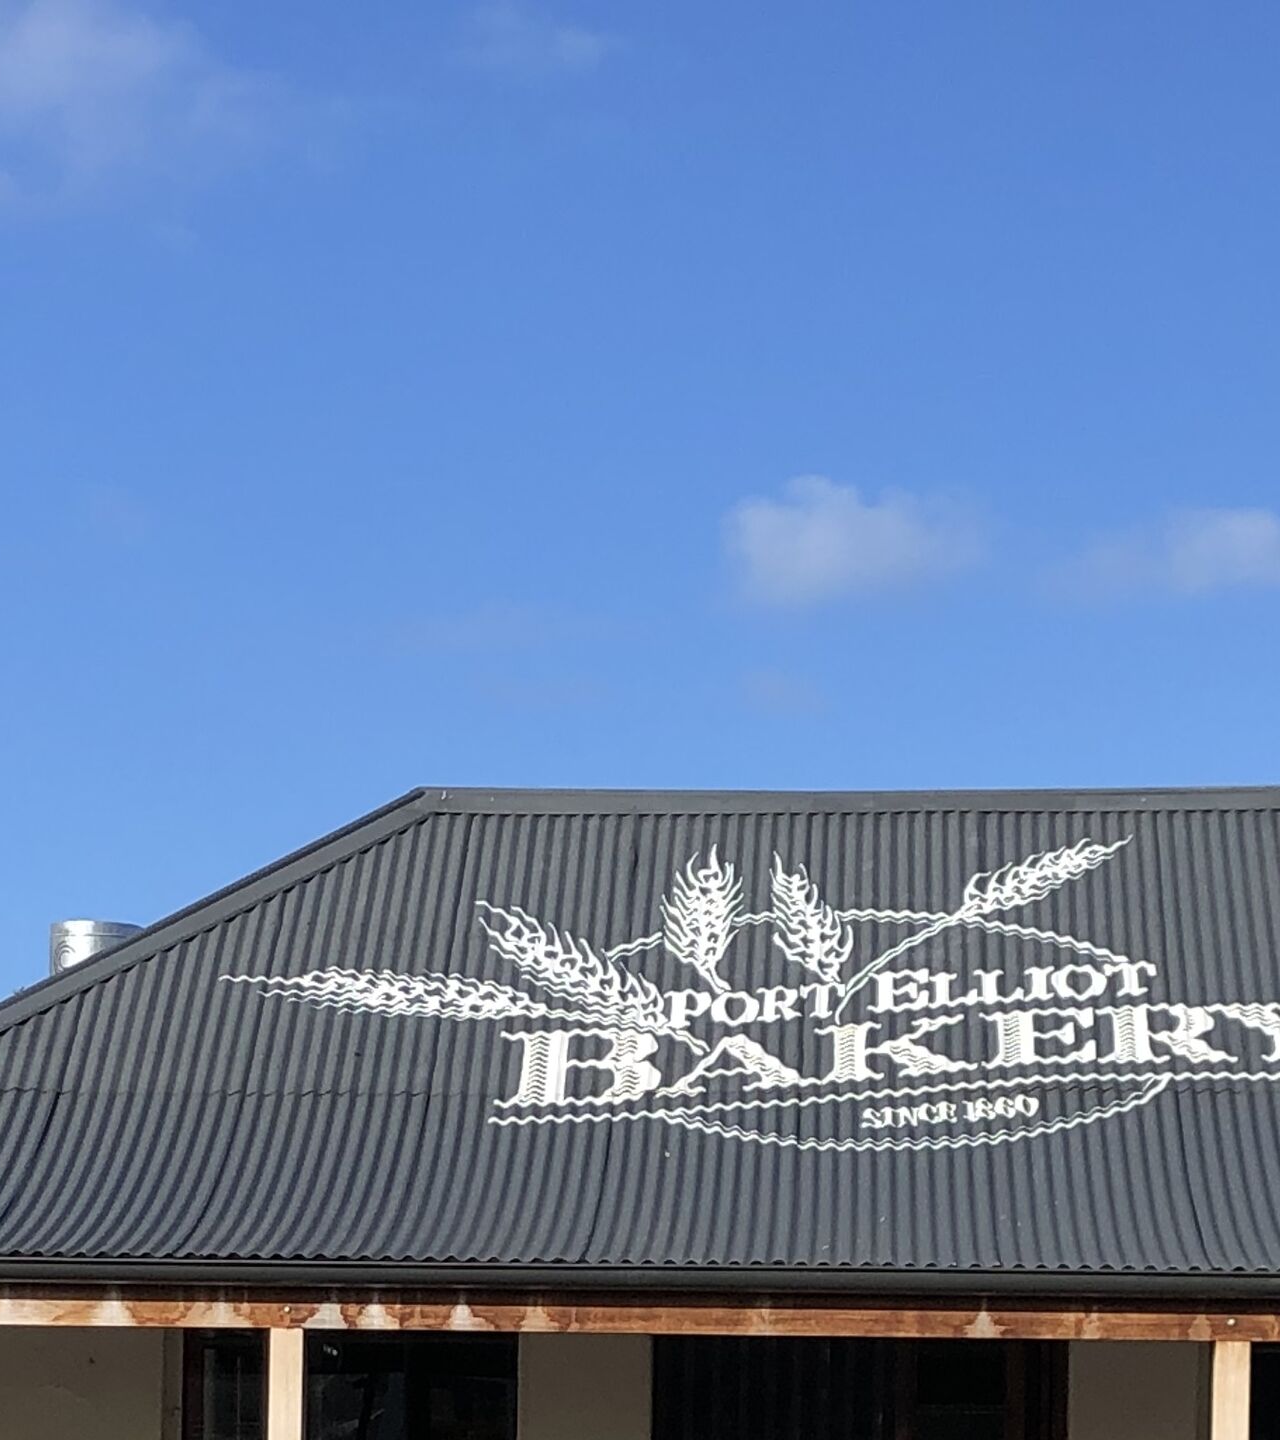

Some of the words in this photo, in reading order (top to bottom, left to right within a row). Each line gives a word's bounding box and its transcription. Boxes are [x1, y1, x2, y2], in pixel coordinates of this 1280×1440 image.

[666, 983, 845, 1028] PORT
[868, 961, 1157, 1014] ELLIOT
[860, 1101, 958, 1129] SINCE
[962, 1093, 1040, 1123] 1860
